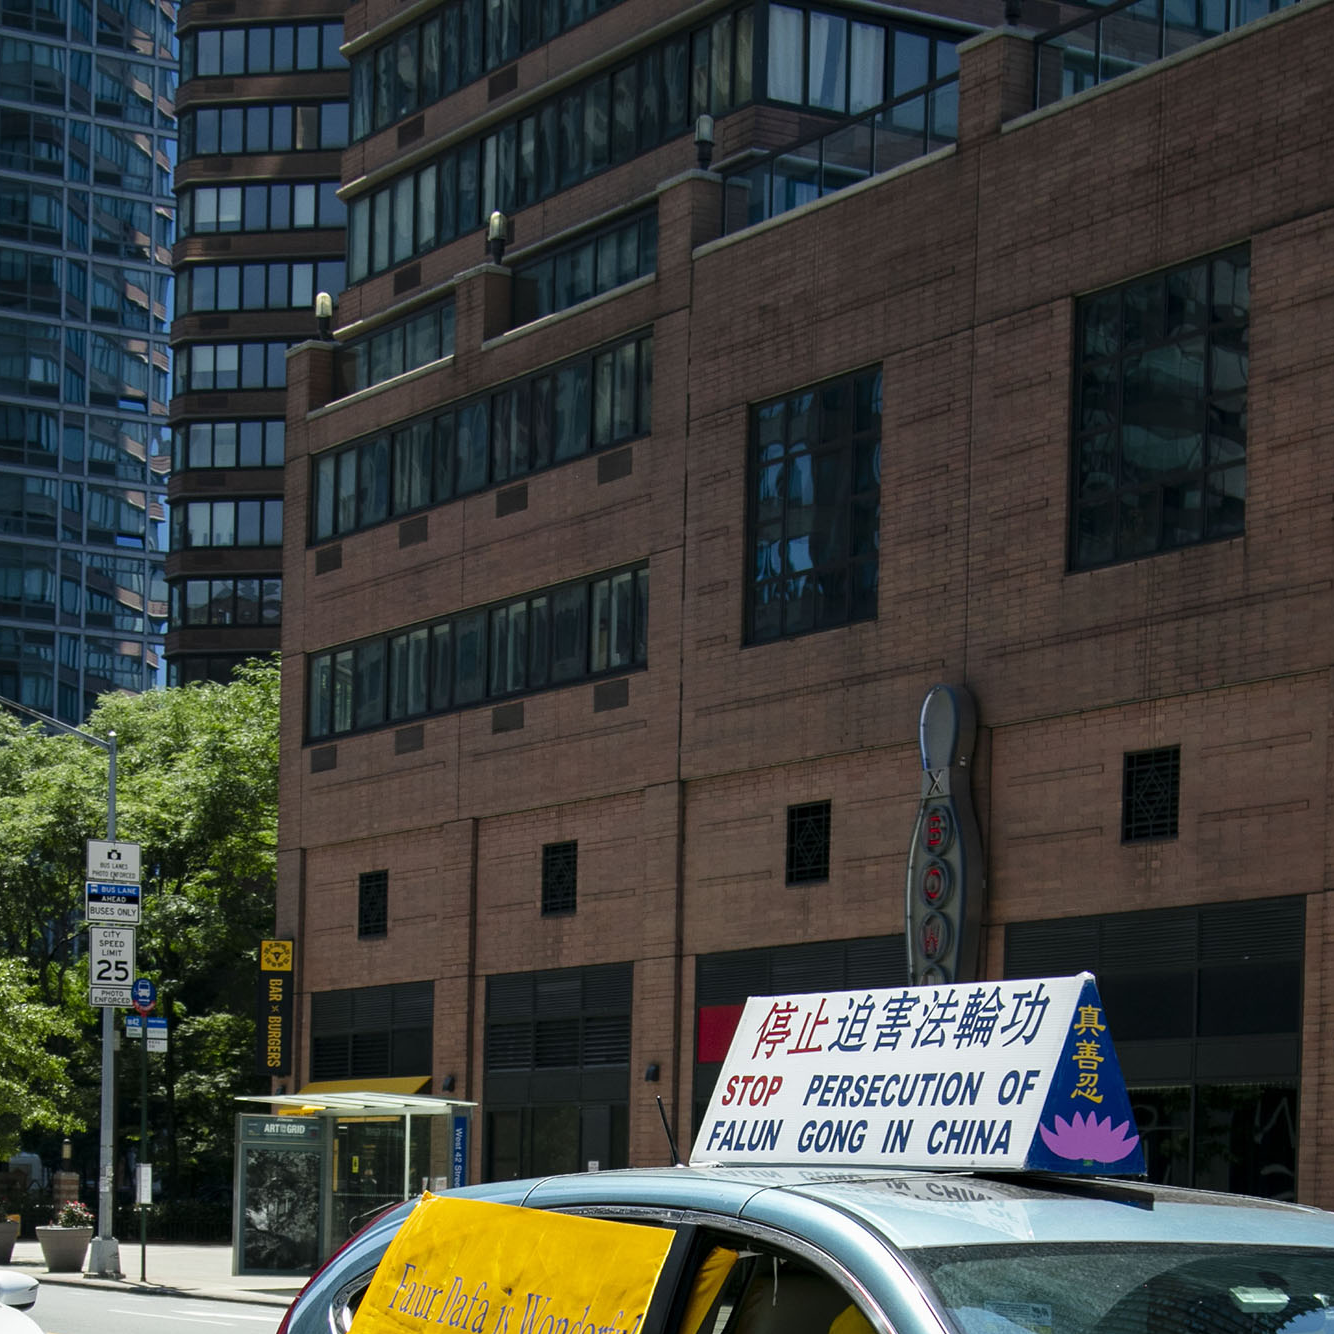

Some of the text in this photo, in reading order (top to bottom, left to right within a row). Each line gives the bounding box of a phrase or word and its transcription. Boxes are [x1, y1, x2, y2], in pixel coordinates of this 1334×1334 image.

[92, 870, 136, 879] PHOTO ENFORCED
[117, 887, 137, 895] LANE
[90, 906, 137, 917] BUSES ONLY
[99, 939, 125, 948] SPEED
[103, 930, 121, 938] CITY
[102, 949, 122, 957] LIMIT
[96, 959, 129, 982] 25
[269, 978, 283, 1002] BAR
[752, 982, 1051, 1061] 停止迫害法輪功
[267, 1016, 282, 1068] BURGERS
[1070, 1004, 1106, 1105] 真善忍
[721, 1069, 1041, 1107] STOP PERSECUTION OF
[264, 1123, 280, 1133] ART
[286, 1124, 306, 1135] GRID
[706, 1119, 1012, 1155] FALUN GONG IN CHINA
[454, 1128, 463, 1188] West 42 Stree
